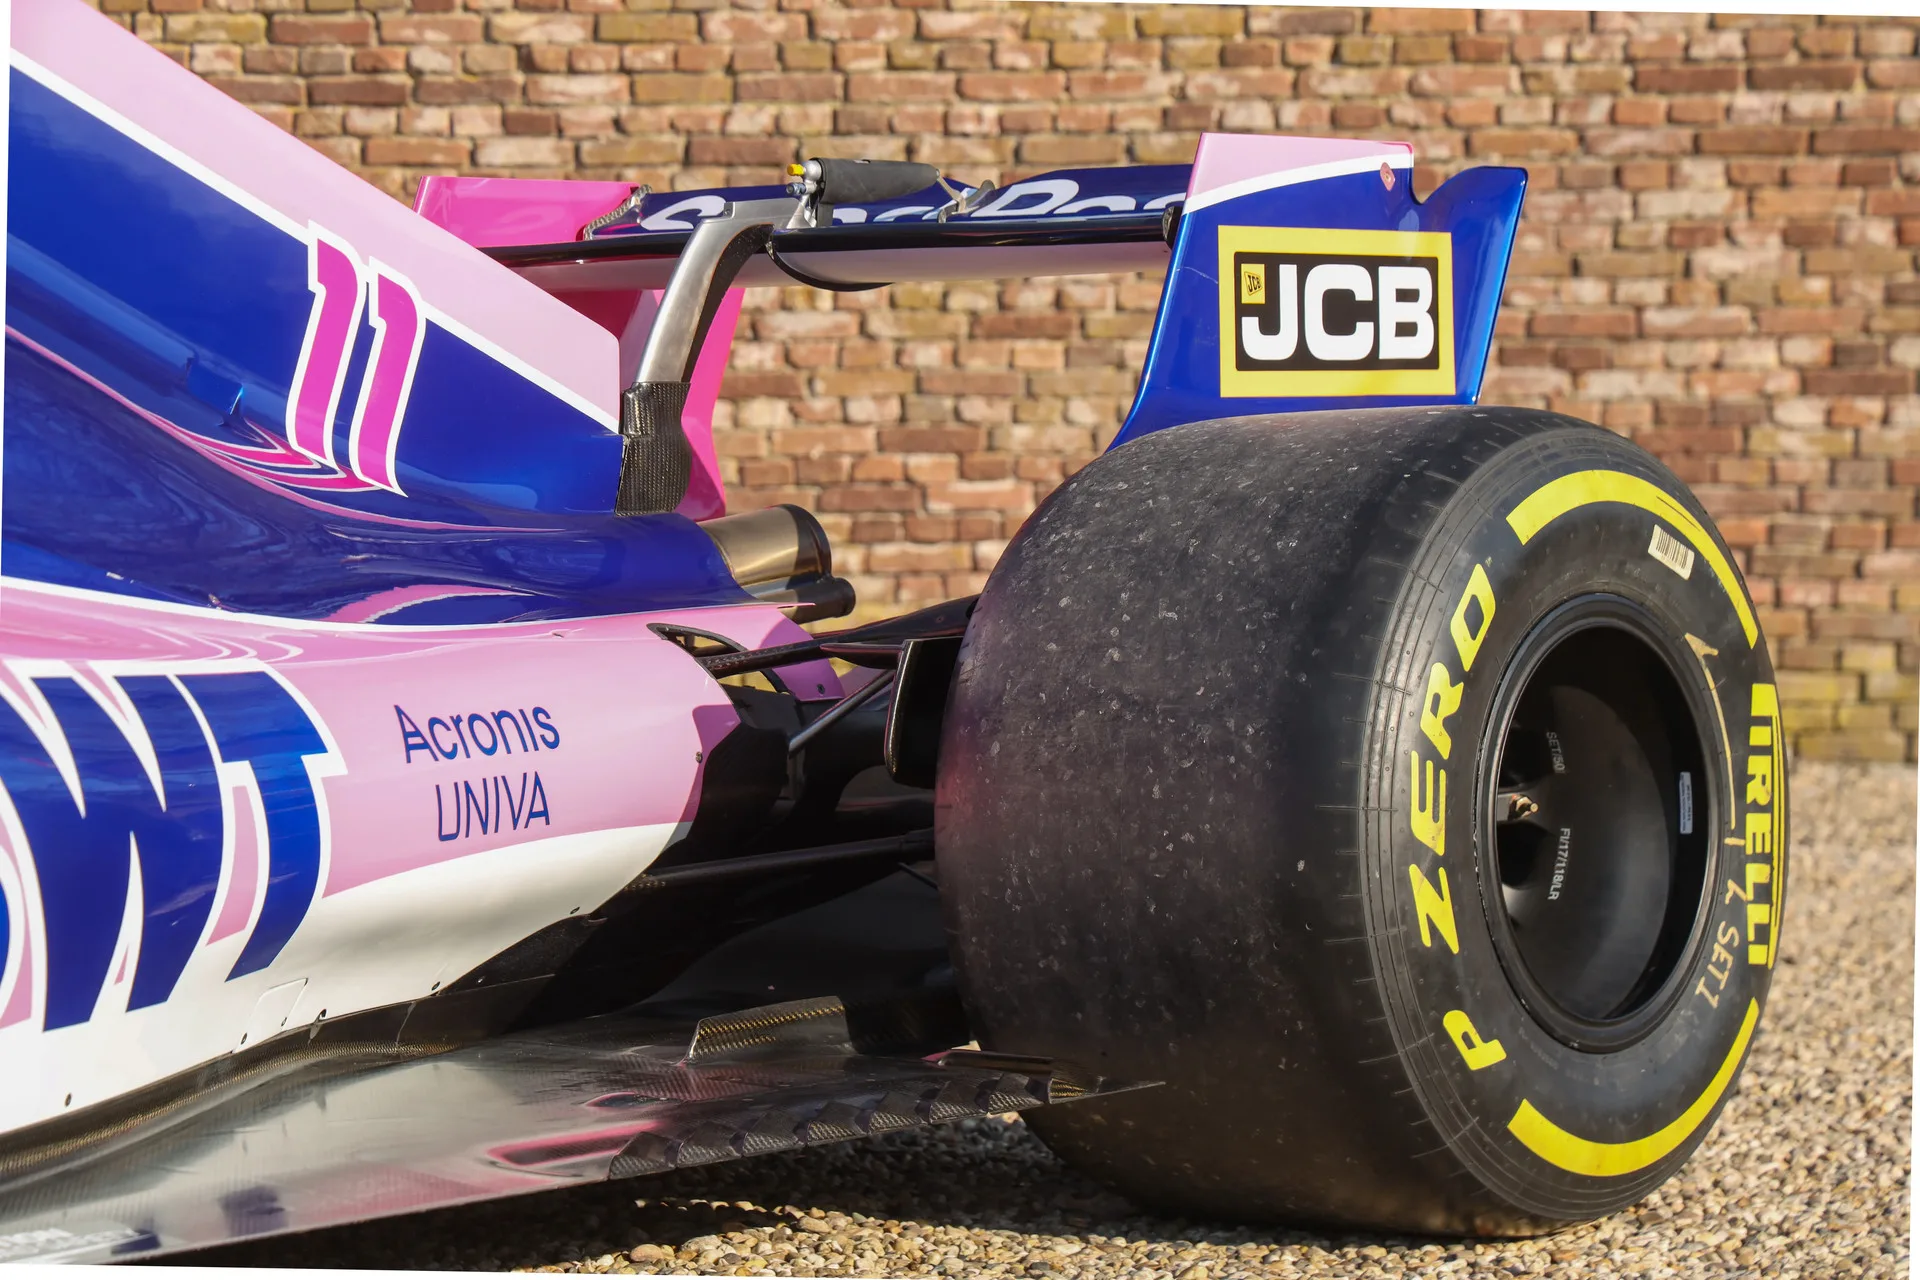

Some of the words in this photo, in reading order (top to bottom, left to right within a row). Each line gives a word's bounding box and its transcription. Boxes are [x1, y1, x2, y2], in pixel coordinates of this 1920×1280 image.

[1241, 263, 1435, 361] JCB
[1246, 274, 1262, 293] JCB
[287, 221, 426, 497] 11
[393, 704, 561, 764] Acronis
[1408, 562, 1497, 955] ZERO
[3, 668, 335, 1033] WT
[435, 771, 551, 842] UNIVA
[1744, 682, 1786, 970] PIRELLI
[1441, 1008, 1507, 1072] P
